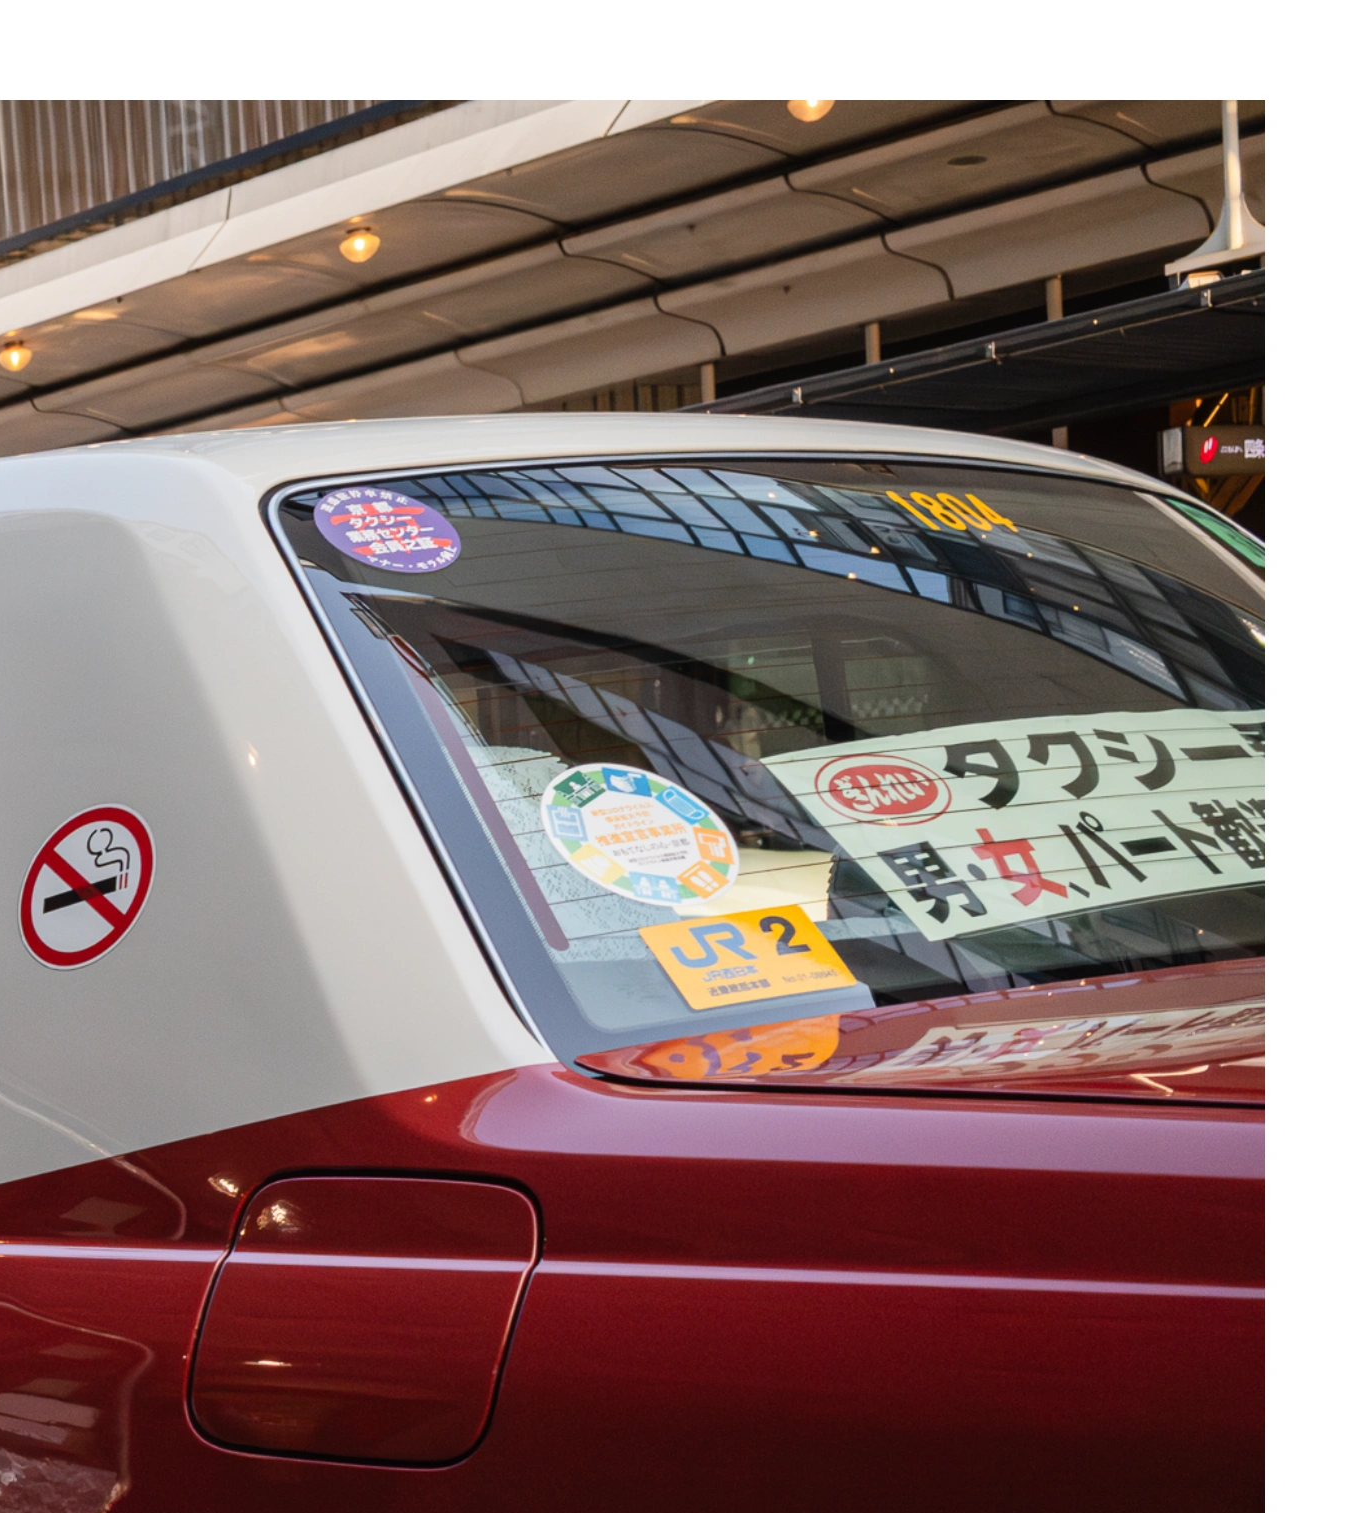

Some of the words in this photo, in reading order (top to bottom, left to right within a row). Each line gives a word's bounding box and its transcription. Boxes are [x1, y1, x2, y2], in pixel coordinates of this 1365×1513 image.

[345, 501, 394, 516] 京都
[885, 491, 1018, 532] 1804
[349, 515, 412, 528] タクシー
[346, 525, 434, 543] 業務センター
[669, 922, 759, 968] JR
[759, 915, 812, 956] 2
[701, 965, 759, 983] JR西日本
